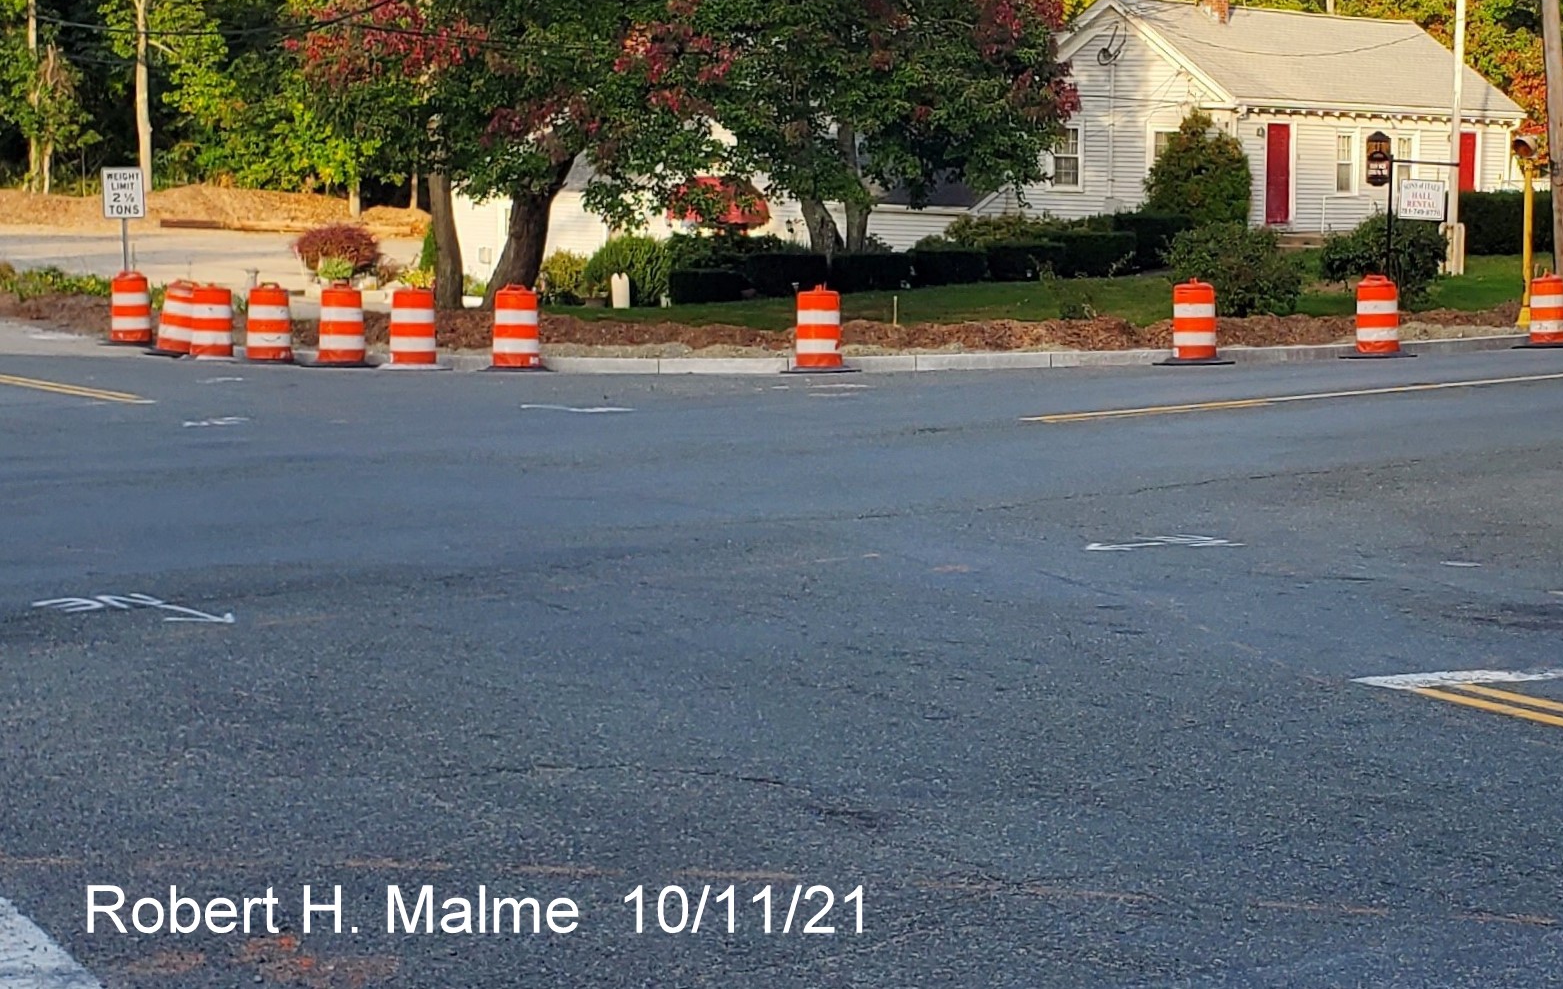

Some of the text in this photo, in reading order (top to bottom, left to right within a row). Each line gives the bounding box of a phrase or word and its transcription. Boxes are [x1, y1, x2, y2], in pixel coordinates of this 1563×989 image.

[111, 182, 135, 191] LIMIT
[113, 193, 121, 202] 2
[109, 205, 140, 215] TONS
